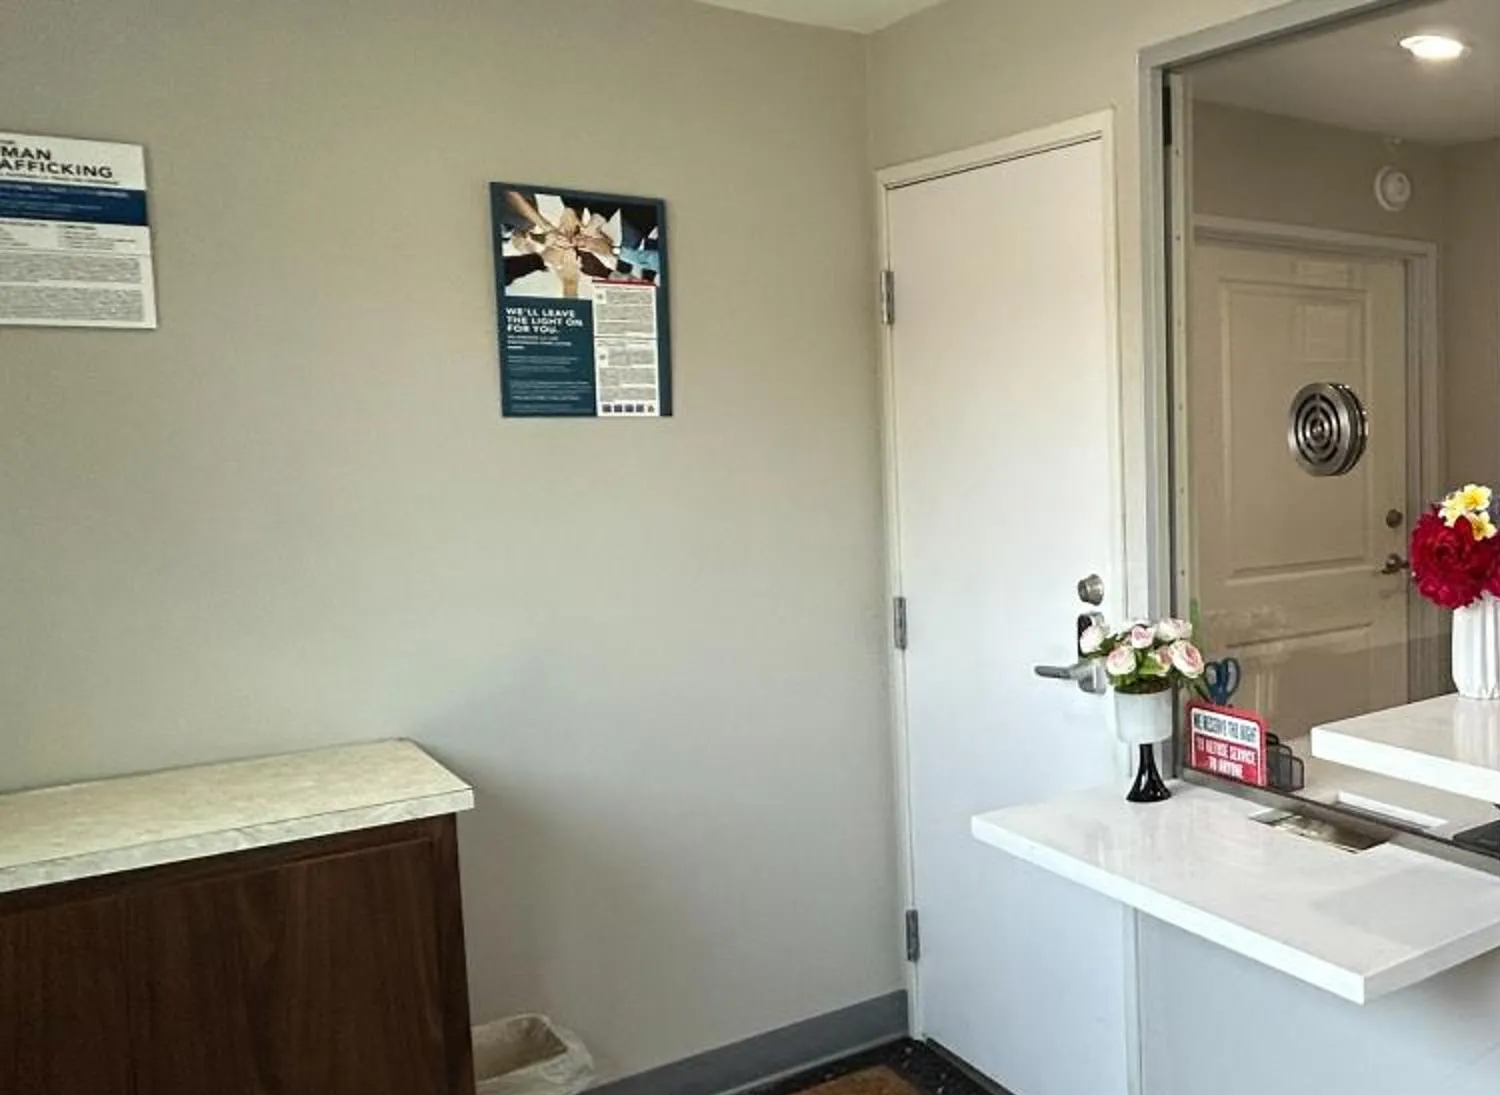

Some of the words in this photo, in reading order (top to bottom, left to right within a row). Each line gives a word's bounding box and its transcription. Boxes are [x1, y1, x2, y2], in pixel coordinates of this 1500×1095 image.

[1, 146, 51, 160] MAN
[0, 159, 113, 179] AFFICKING
[506, 307, 539, 317] WE'LL
[541, 308, 575, 318] LEAVE
[506, 316, 528, 325] THE
[531, 317, 562, 325] LIGHT
[565, 318, 584, 327] ON
[507, 324, 529, 333] FOR
